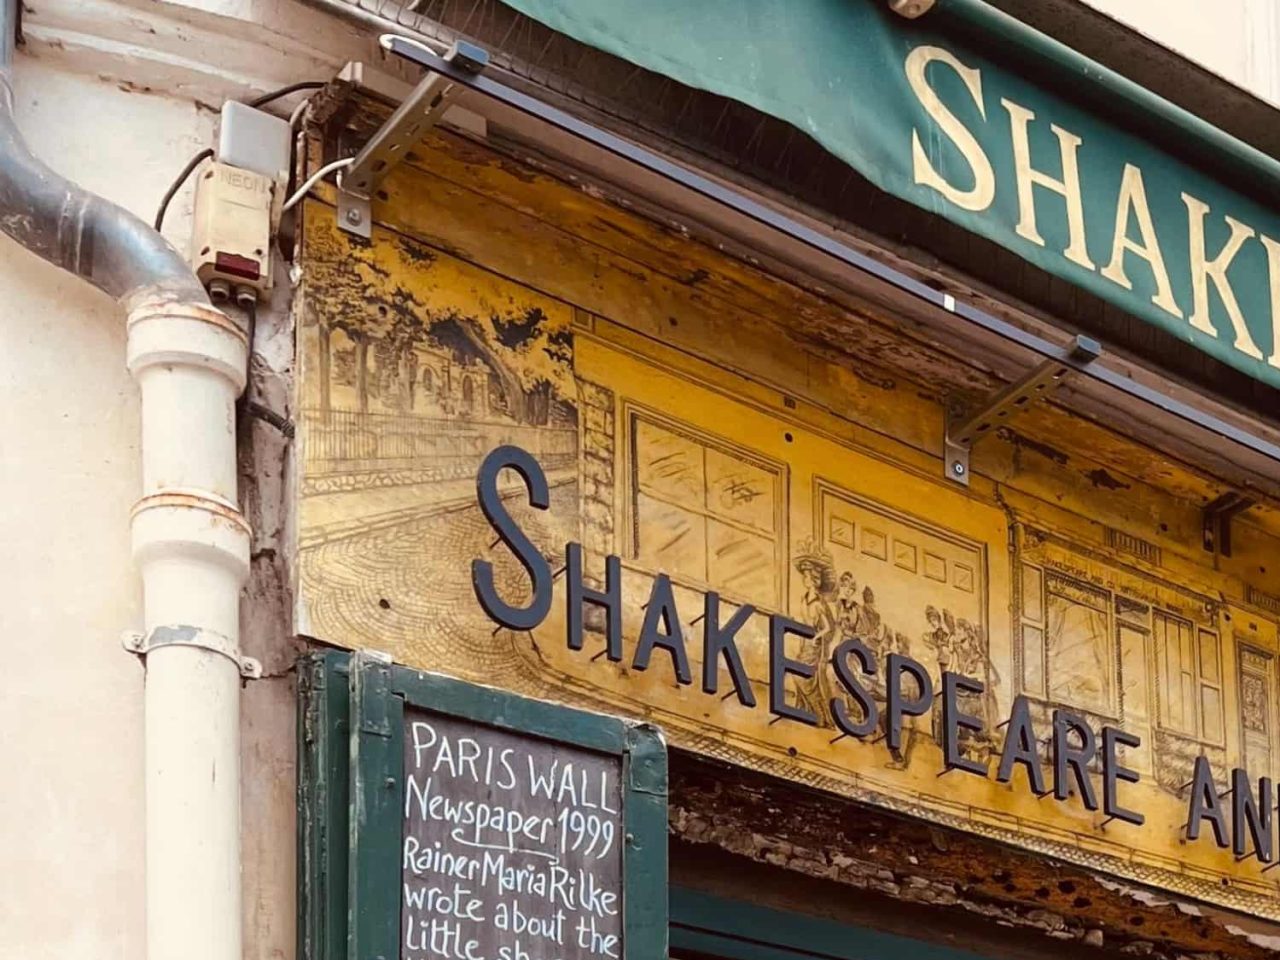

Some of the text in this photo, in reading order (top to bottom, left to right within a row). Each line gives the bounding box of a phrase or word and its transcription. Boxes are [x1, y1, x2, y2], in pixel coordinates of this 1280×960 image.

[221, 170, 265, 193] NEON
[472, 445, 1145, 825] SHAKESPEARE
[411, 722, 617, 814] PARIS WALL
[405, 774, 614, 859] Newspaper 1999
[403, 836, 618, 917] Rainer Maria Rilke
[404, 883, 619, 958] wrote about the
[406, 916, 484, 960] little
